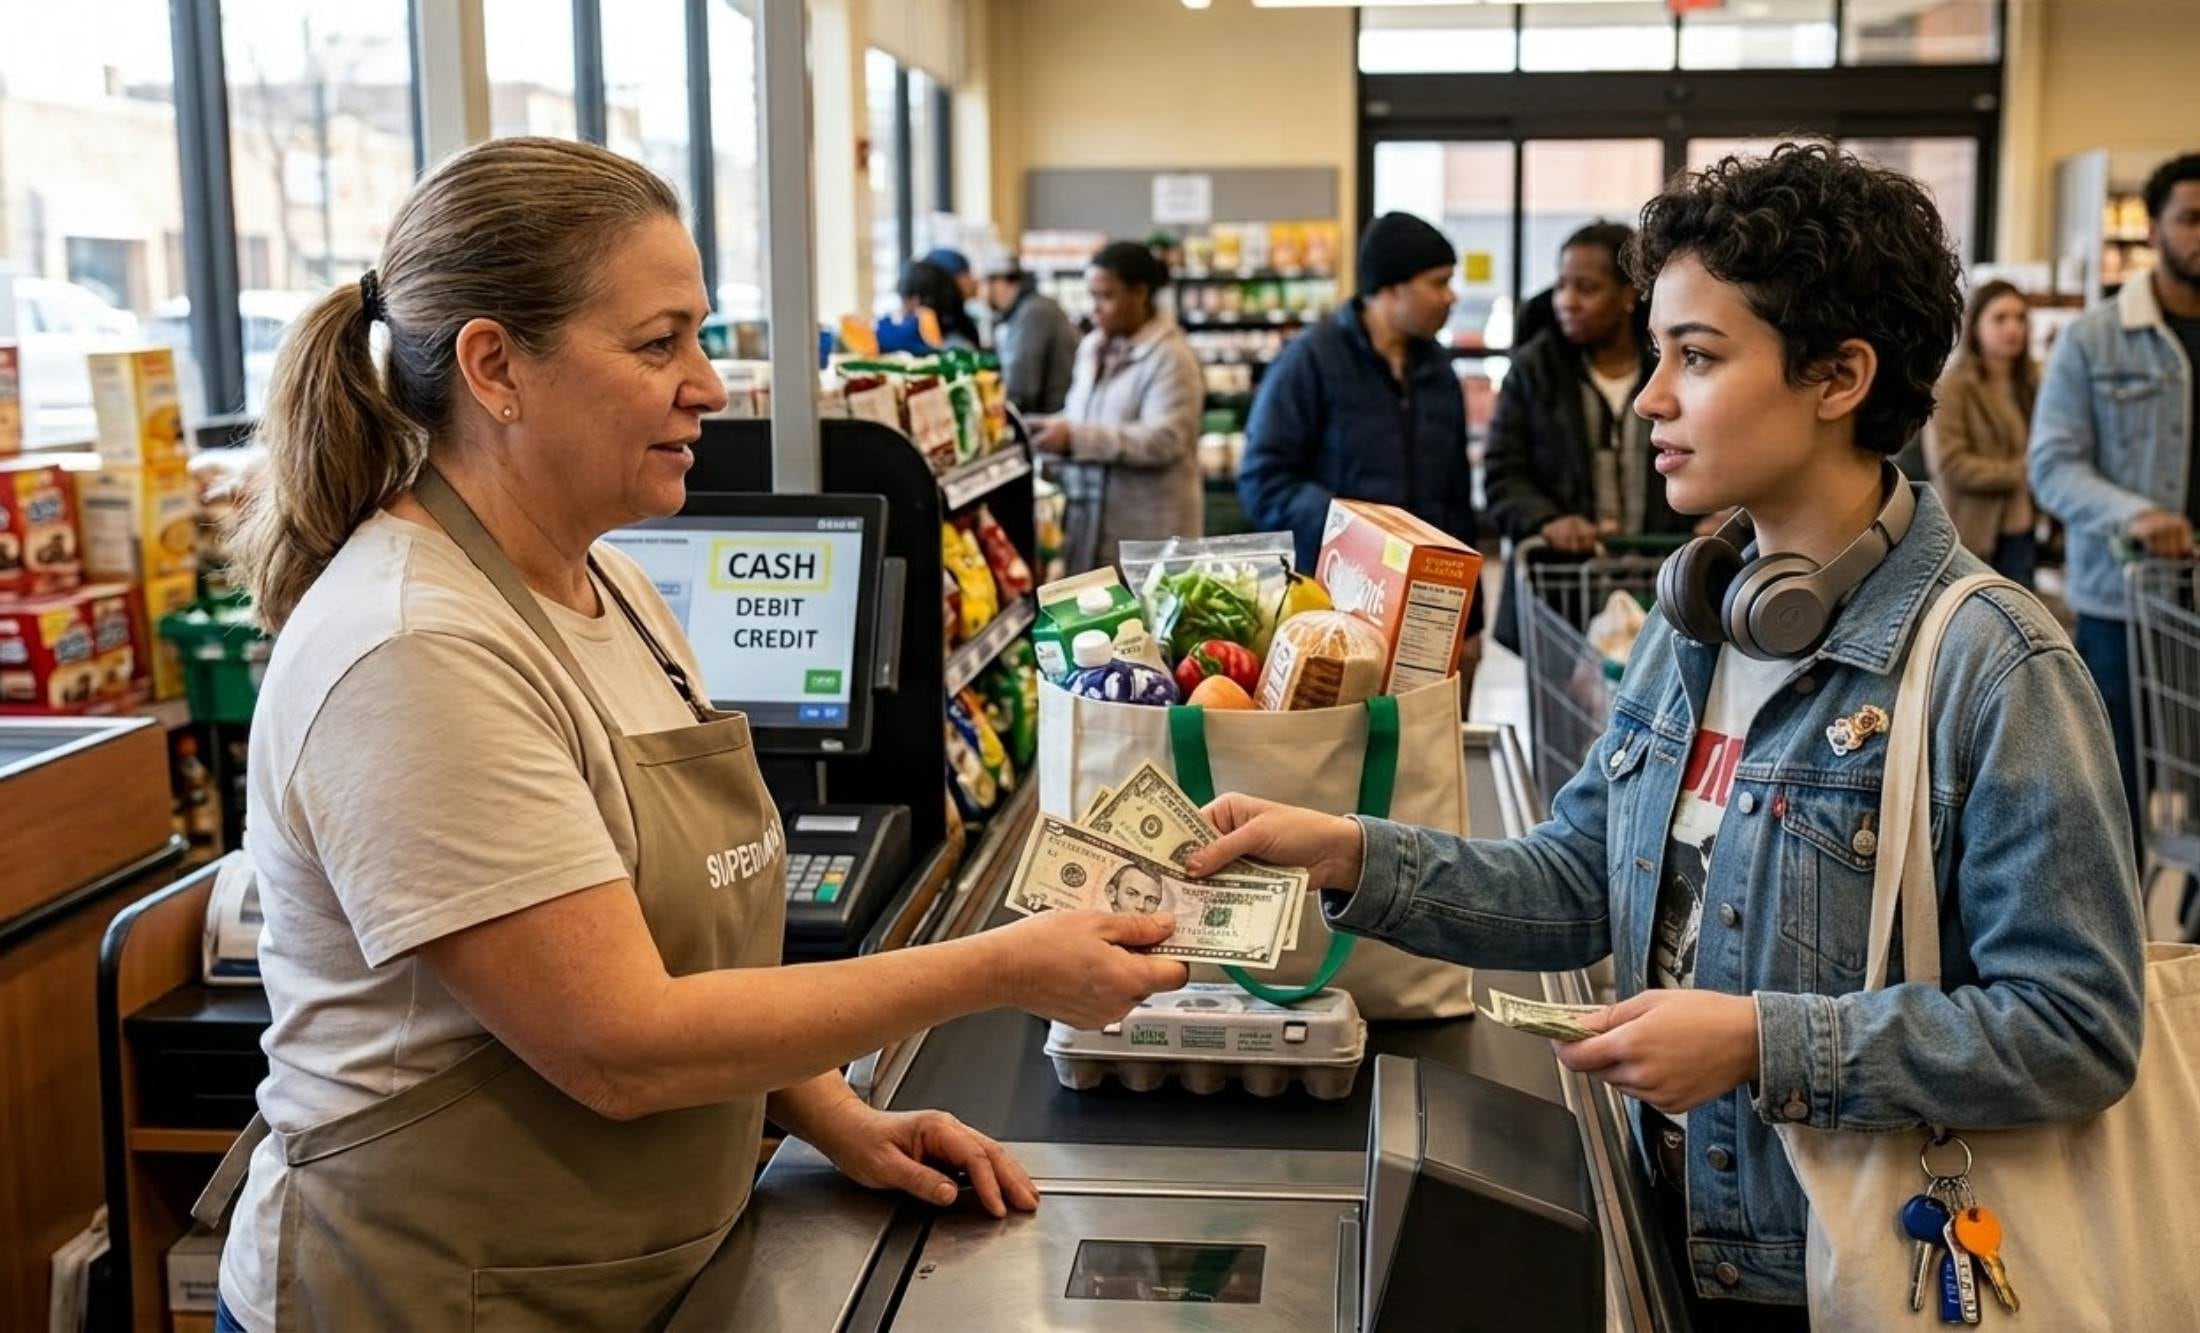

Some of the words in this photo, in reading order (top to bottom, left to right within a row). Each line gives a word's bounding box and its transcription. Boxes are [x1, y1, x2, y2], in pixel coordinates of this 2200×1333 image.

[728, 552, 816, 580] CASH
[736, 597, 805, 617] DEBIT
[733, 628, 819, 649] CREDIT
